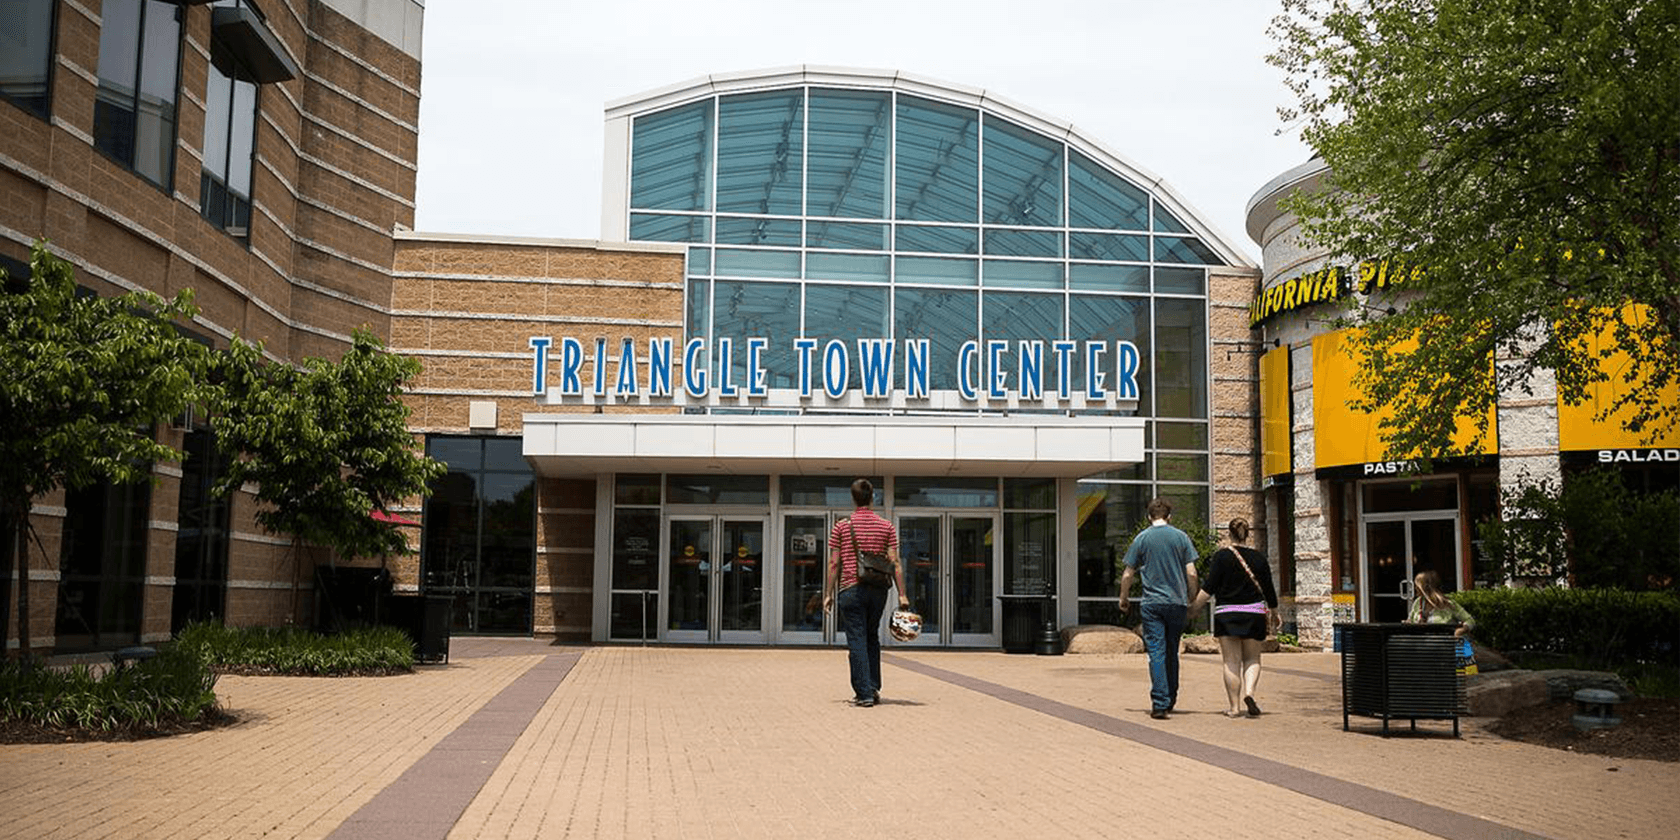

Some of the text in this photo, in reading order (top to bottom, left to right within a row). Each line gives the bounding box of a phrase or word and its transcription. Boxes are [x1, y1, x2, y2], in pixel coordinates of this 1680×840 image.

[529, 337, 1140, 401] TRIANGLE TOWN CENTER
[1598, 449, 1680, 462] SALAD
